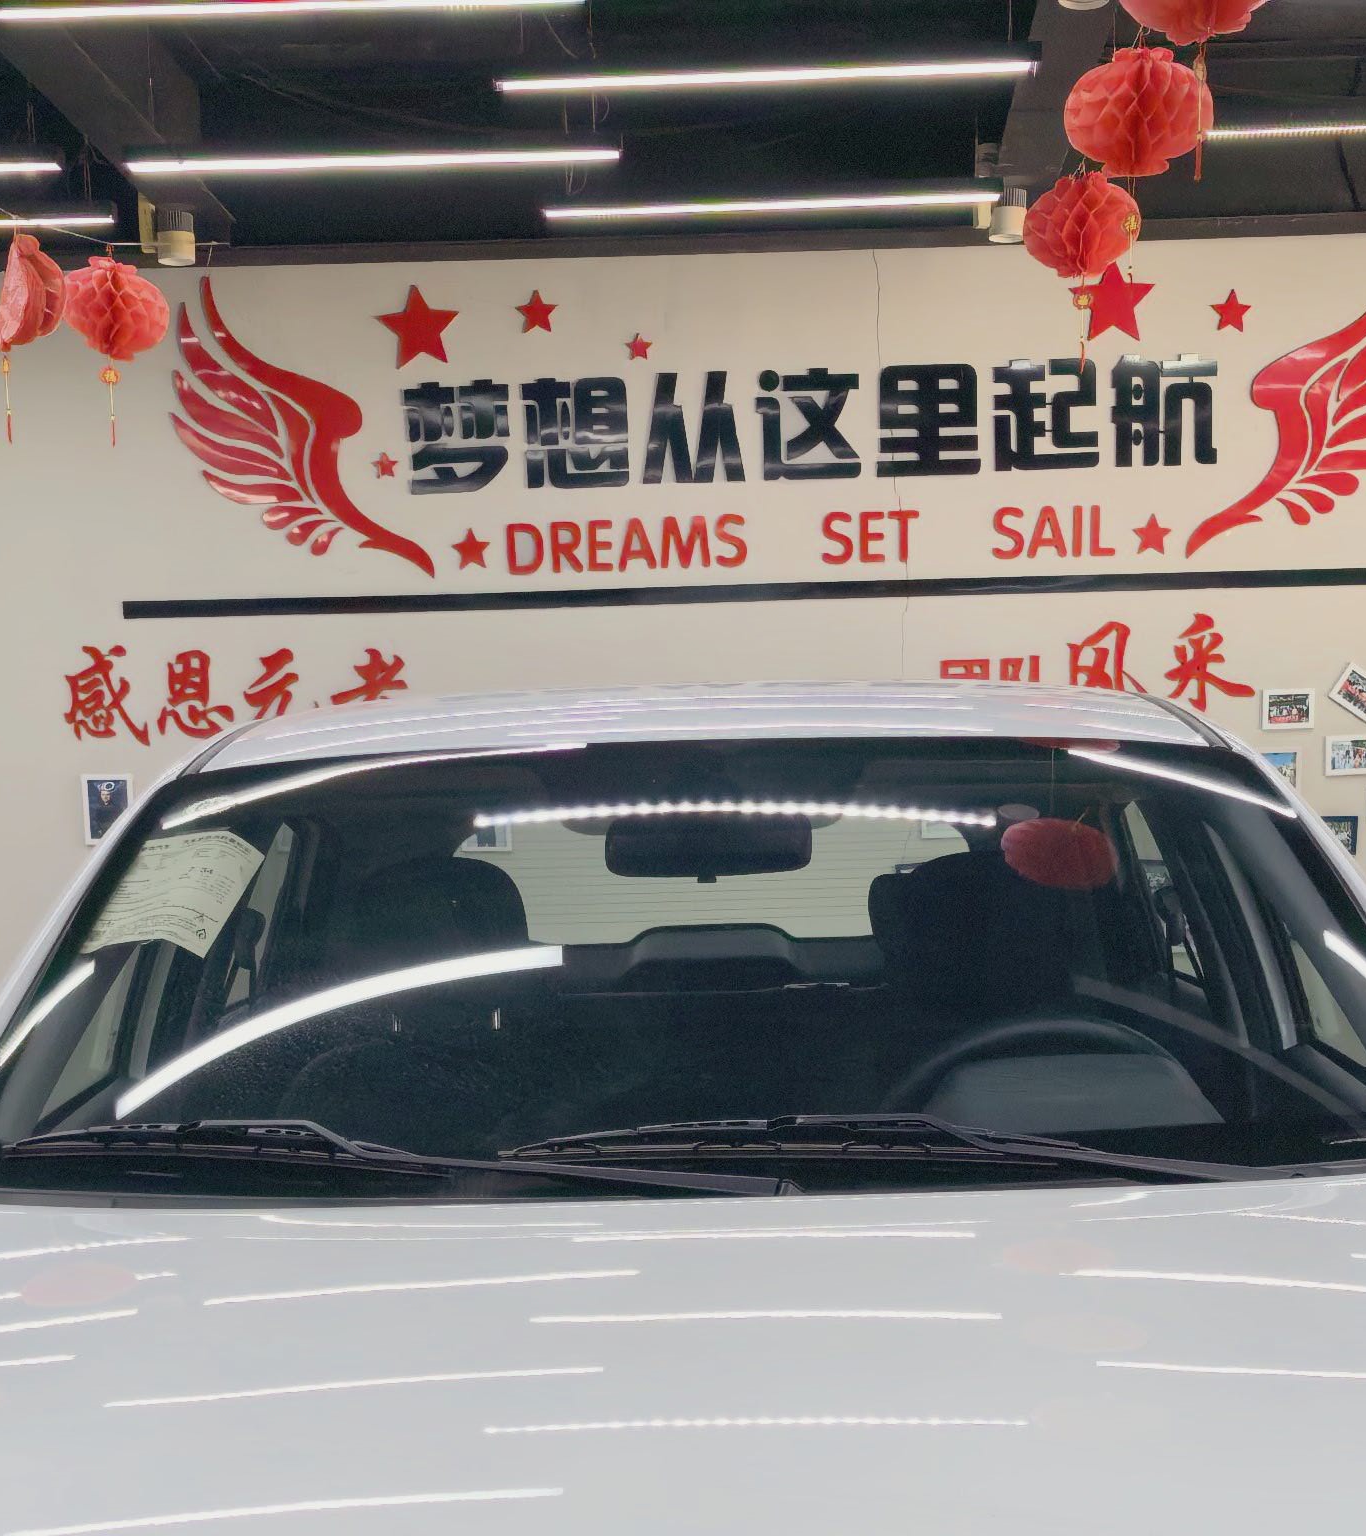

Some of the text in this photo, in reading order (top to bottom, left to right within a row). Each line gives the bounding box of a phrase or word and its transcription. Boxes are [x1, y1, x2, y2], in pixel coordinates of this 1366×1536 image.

[401, 353, 1218, 496] 梦想从这里起航
[506, 504, 1115, 575] DREAMS SET SAIL
